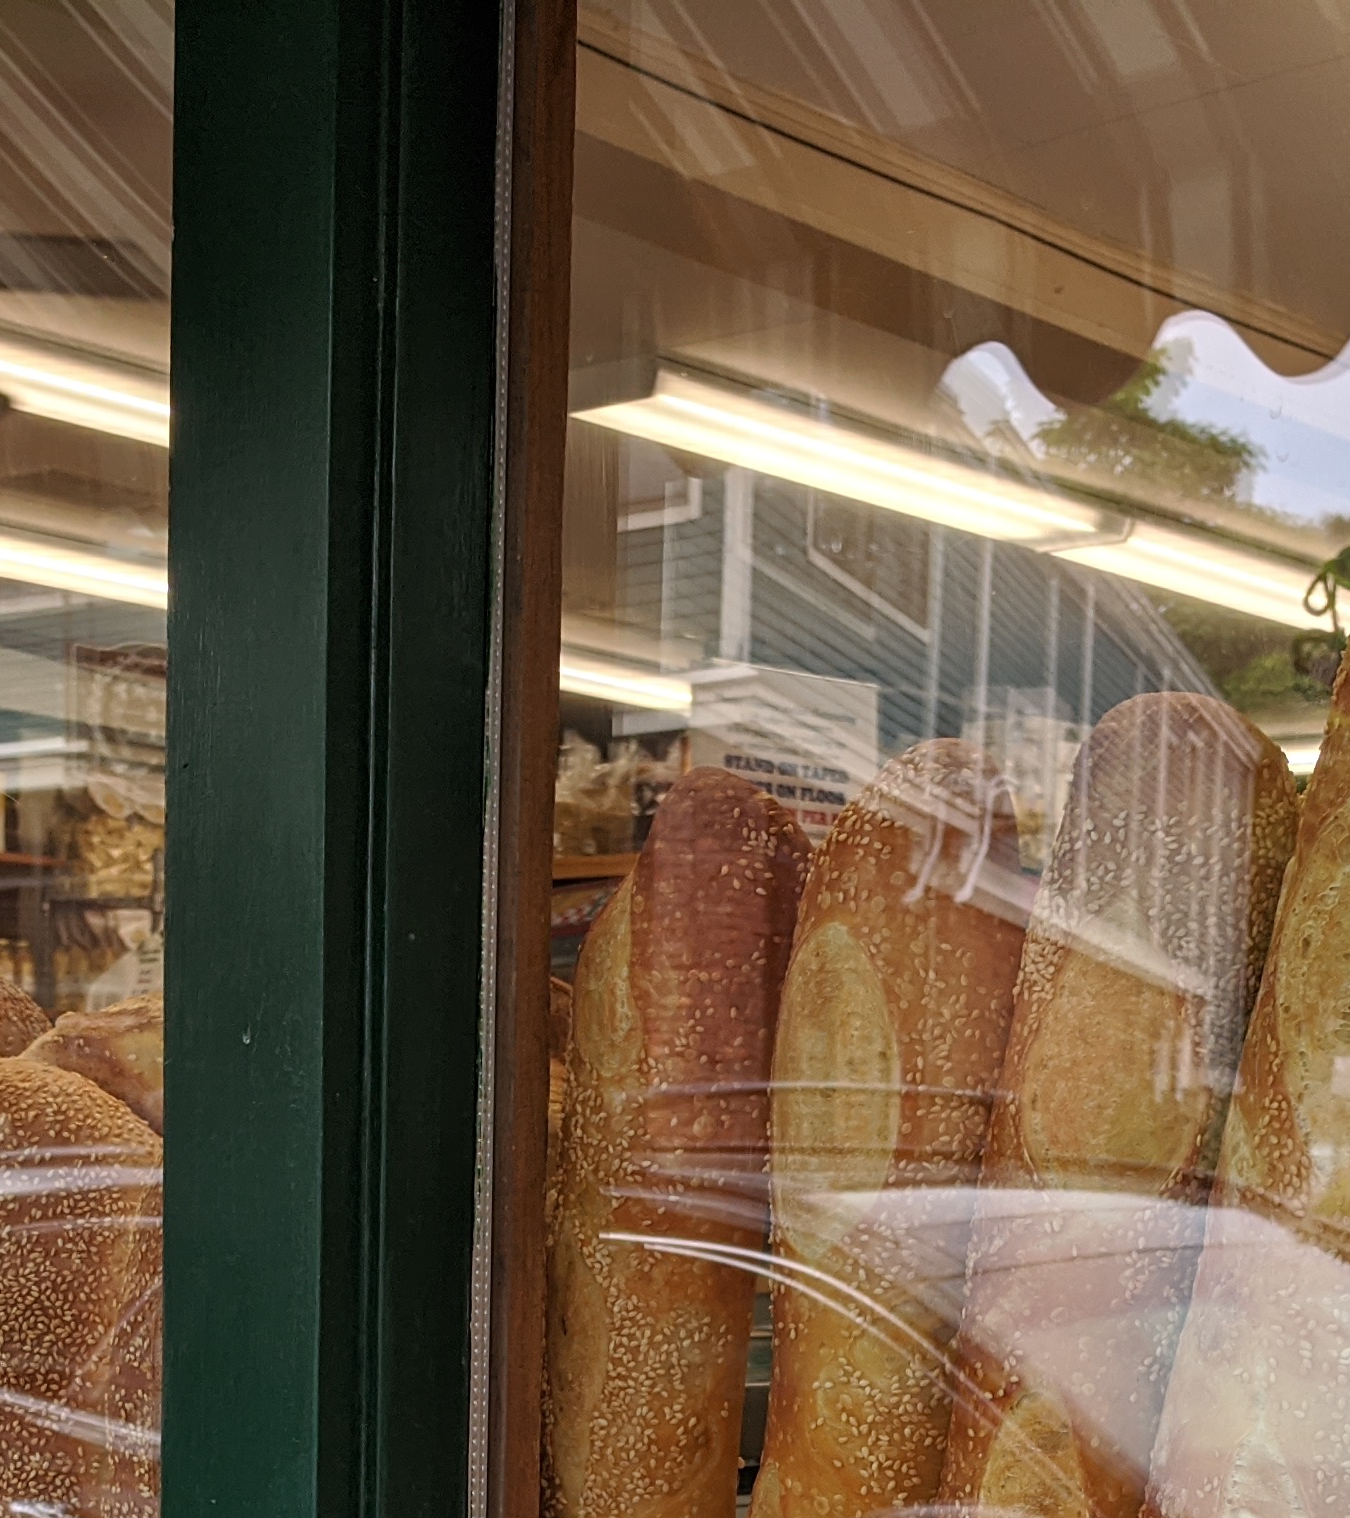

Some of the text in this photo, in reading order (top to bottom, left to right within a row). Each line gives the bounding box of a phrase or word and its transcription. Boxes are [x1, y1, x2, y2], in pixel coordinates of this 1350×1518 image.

[724, 754, 775, 774] STAND
[777, 761, 798, 776] ON
[776, 783, 797, 799] ON
